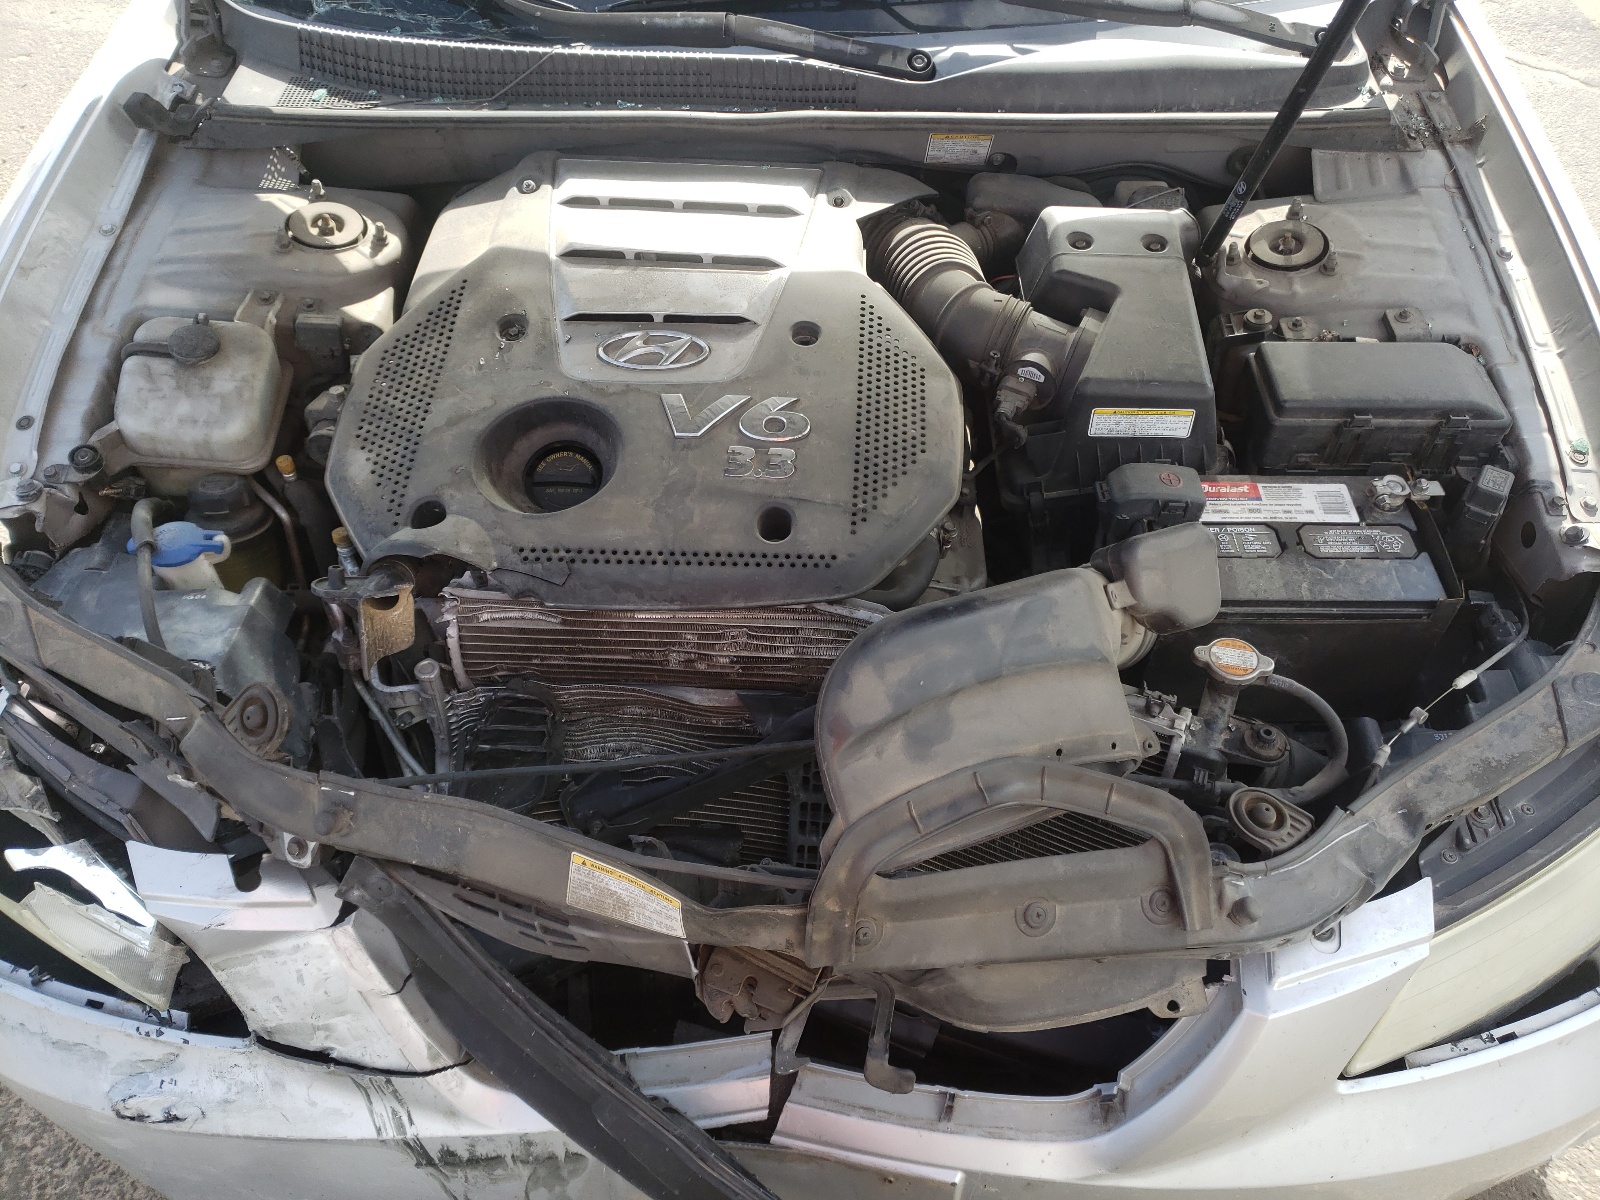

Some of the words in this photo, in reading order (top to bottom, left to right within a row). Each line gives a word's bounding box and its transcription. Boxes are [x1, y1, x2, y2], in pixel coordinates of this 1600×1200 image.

[661, 393, 811, 442] V6
[546, 451, 574, 463] OWNER'S
[724, 445, 797, 478] 3.3
[1201, 484, 1250, 493] Duralast
